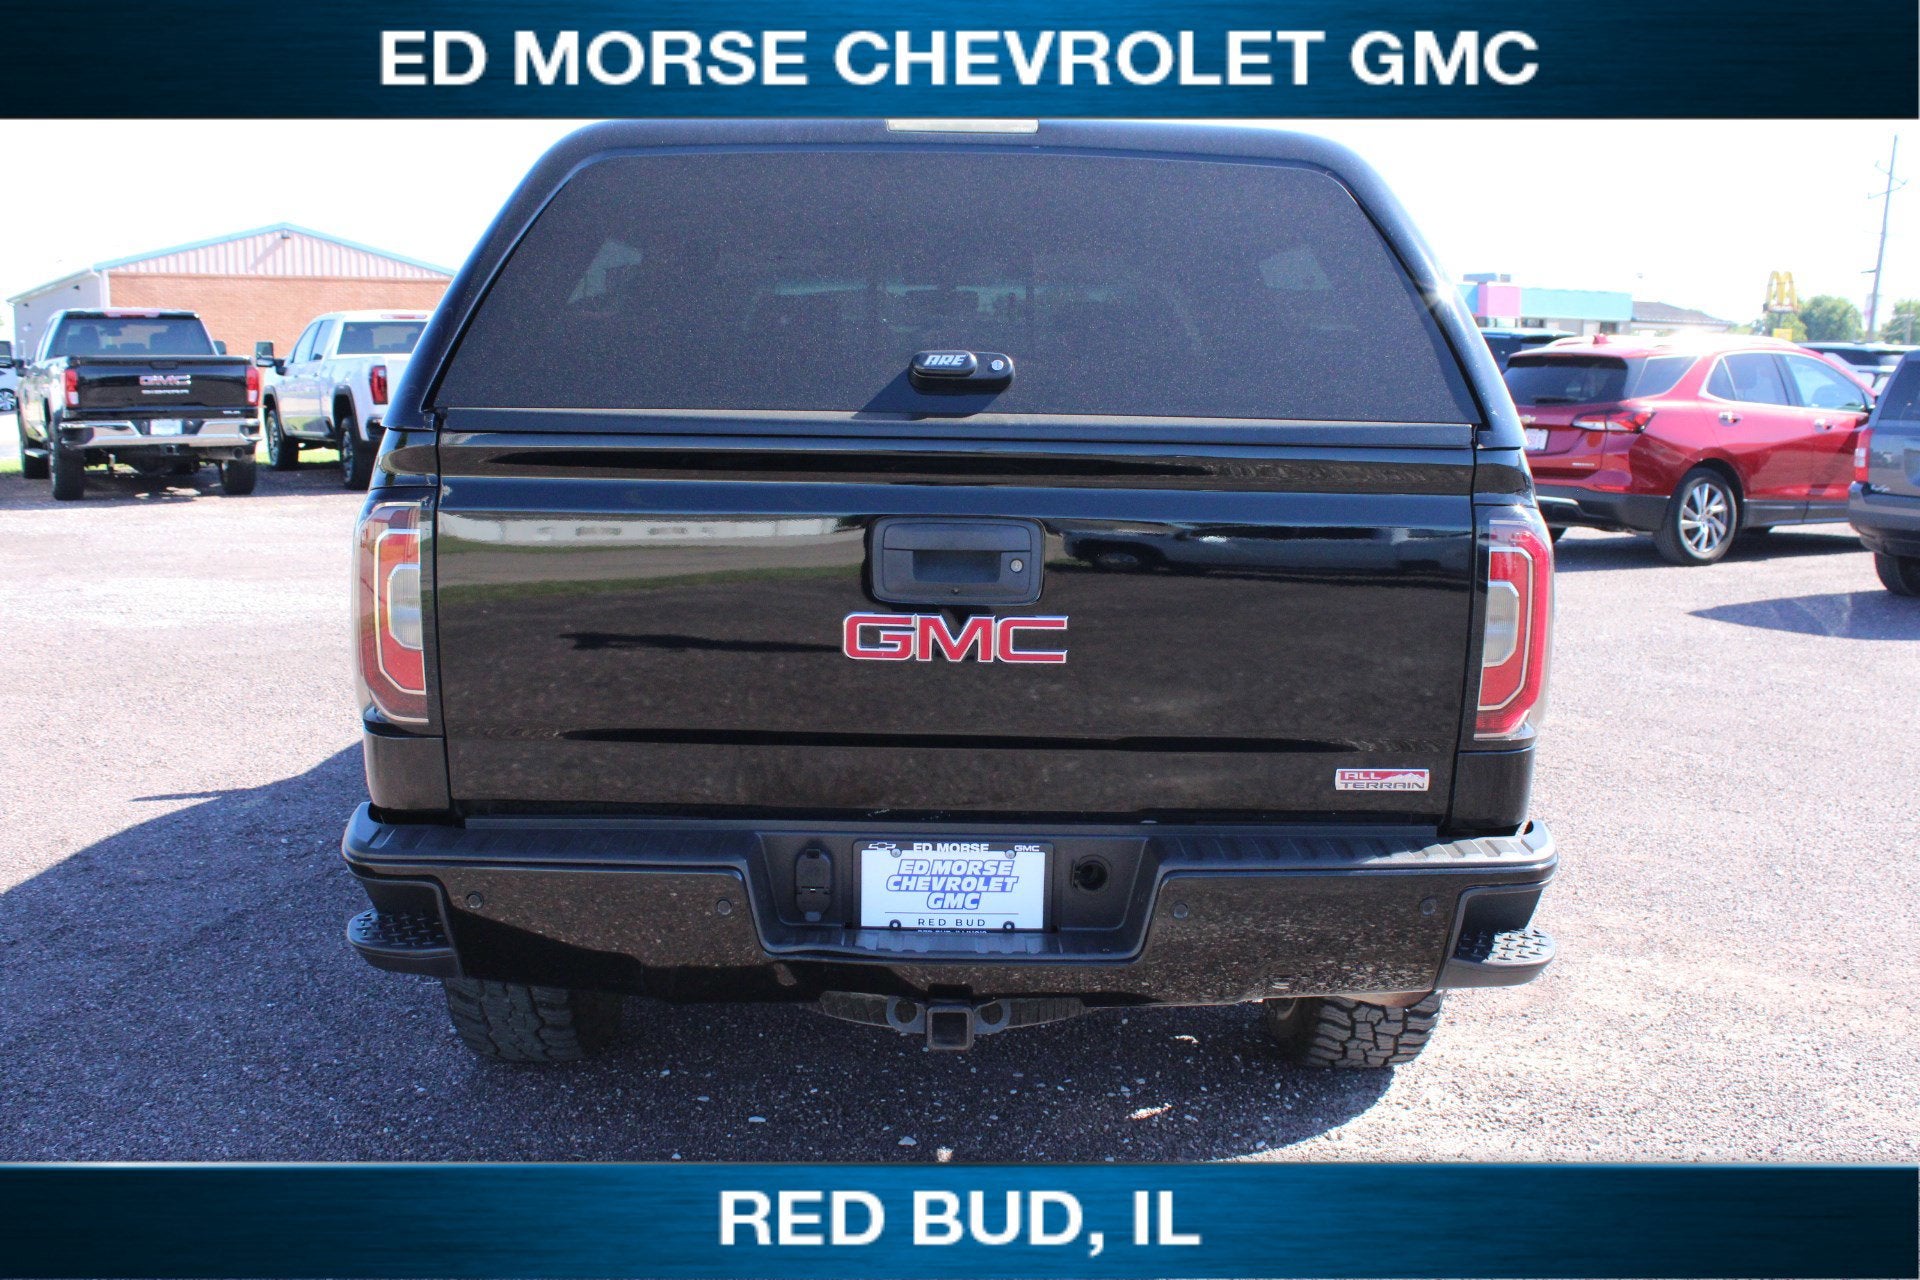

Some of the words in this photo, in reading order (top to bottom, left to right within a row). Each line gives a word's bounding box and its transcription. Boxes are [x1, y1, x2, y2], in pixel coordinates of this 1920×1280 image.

[924, 354, 967, 367] ARE
[139, 374, 192, 386] GMC
[842, 611, 1069, 664] GMC
[1344, 772, 1382, 780] ALL
[1341, 781, 1425, 789] TERRAIN
[913, 842, 933, 852] ED
[934, 842, 990, 852] MORSE
[897, 858, 931, 876] ED
[930, 859, 1015, 876] MORSE
[886, 875, 1020, 893] CHEVROLET
[926, 892, 982, 910] GMC
[918, 918, 947, 927] RED
[955, 918, 986, 927] BUD
